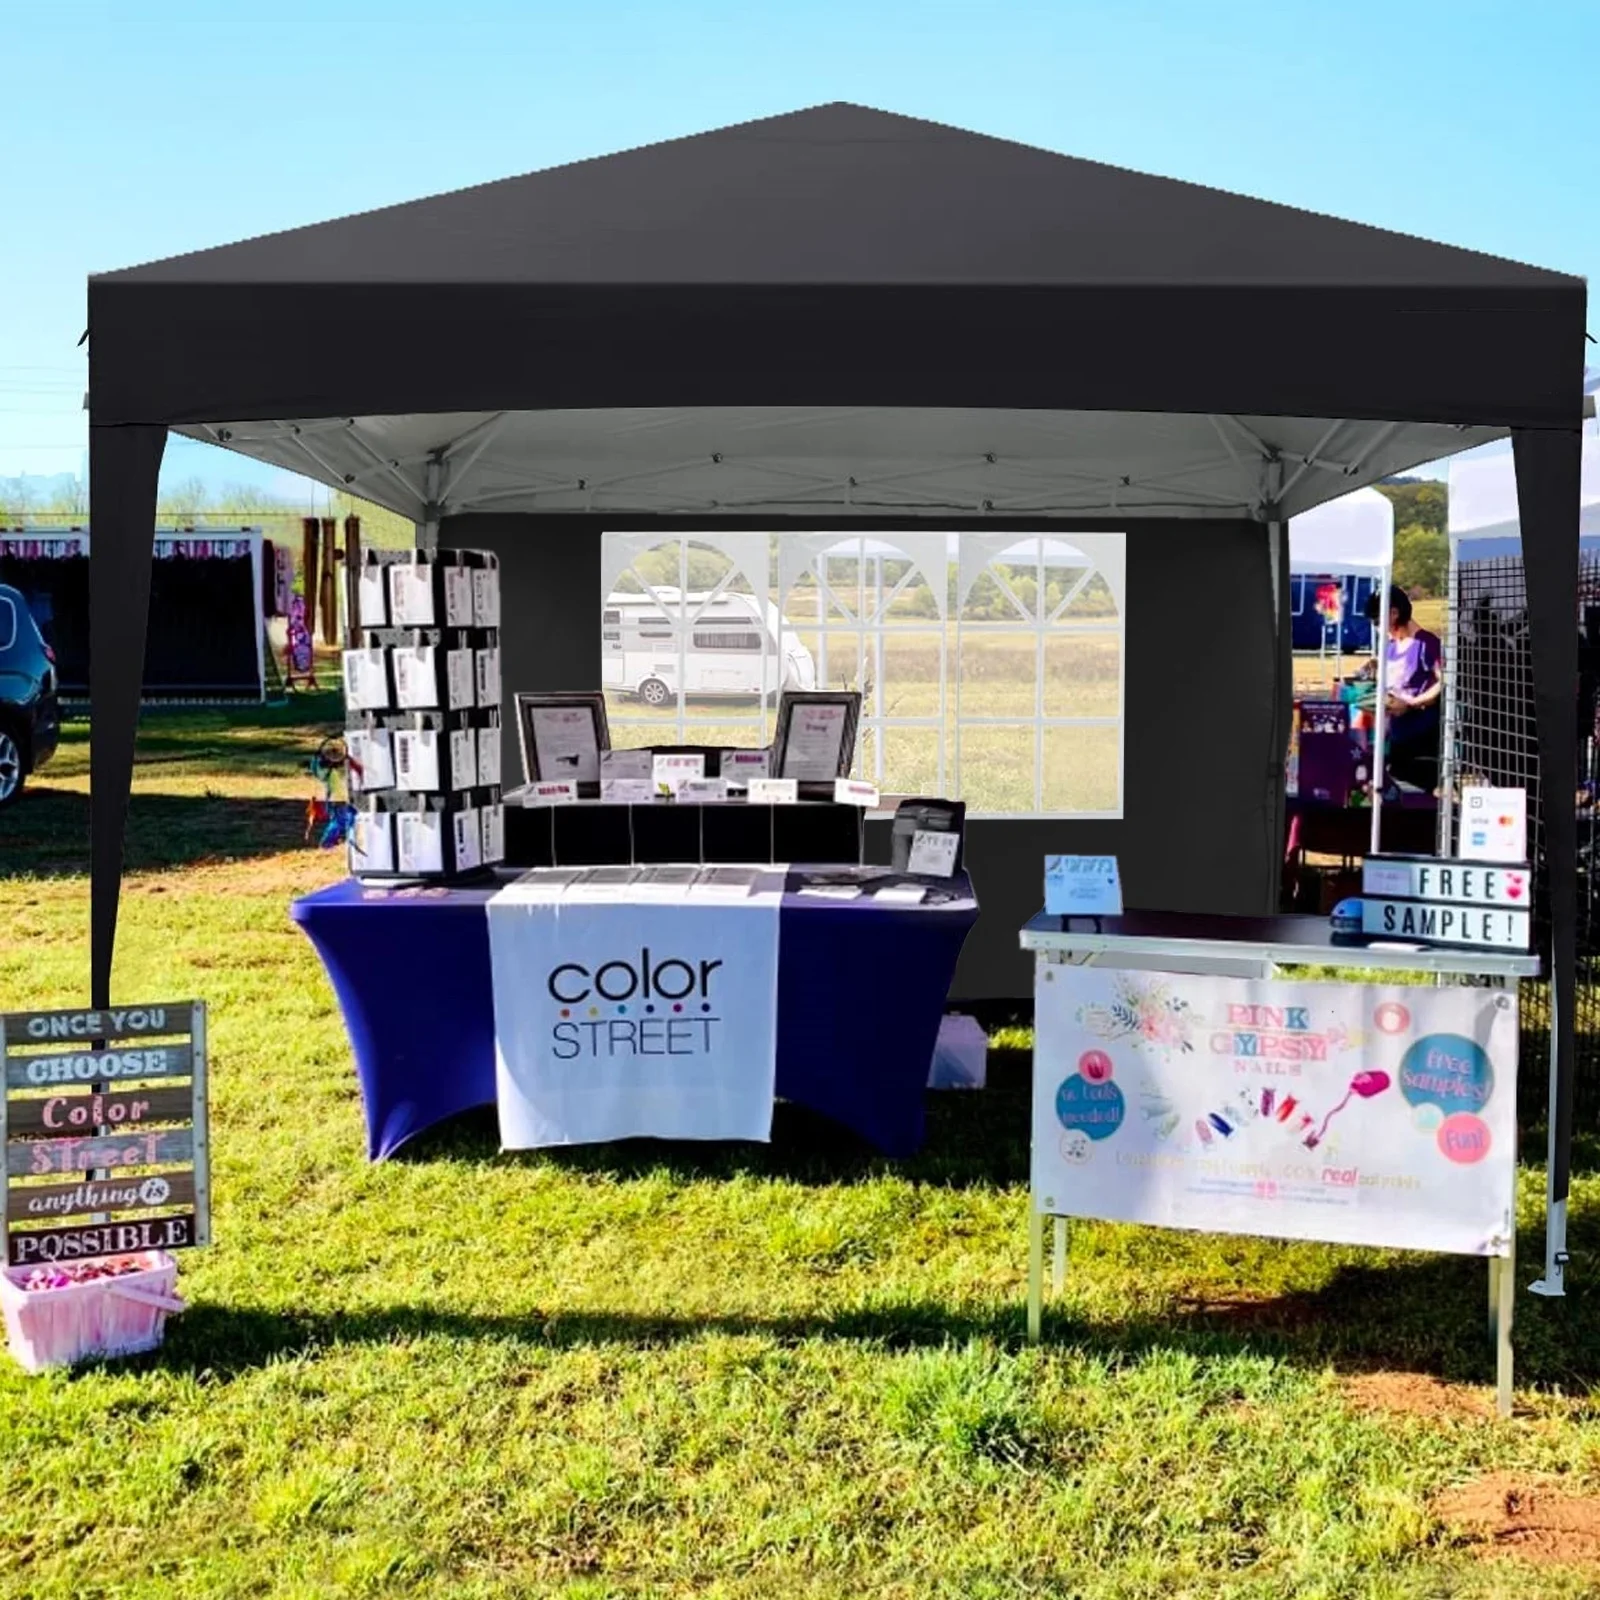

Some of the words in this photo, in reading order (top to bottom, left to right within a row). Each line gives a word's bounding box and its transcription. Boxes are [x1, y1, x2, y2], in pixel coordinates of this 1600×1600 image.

[1419, 867, 1496, 899] FREE
[1384, 904, 1514, 943] SAMPLE!
[547, 946, 723, 1004] color
[27, 1012, 103, 1037] ONCE
[108, 1008, 166, 1032] YOU
[1225, 1003, 1308, 1030] PINK
[551, 1017, 721, 1060] STREET
[1209, 1031, 1327, 1061] GYPSY
[26, 1050, 168, 1084] CHOOSE
[1233, 1060, 1302, 1077] NAILS
[42, 1095, 149, 1129] Color
[1321, 1166, 1358, 1187] real
[28, 1183, 140, 1214] anything
[145, 1180, 166, 1199] is
[14, 1218, 189, 1263] POSSIBLE
